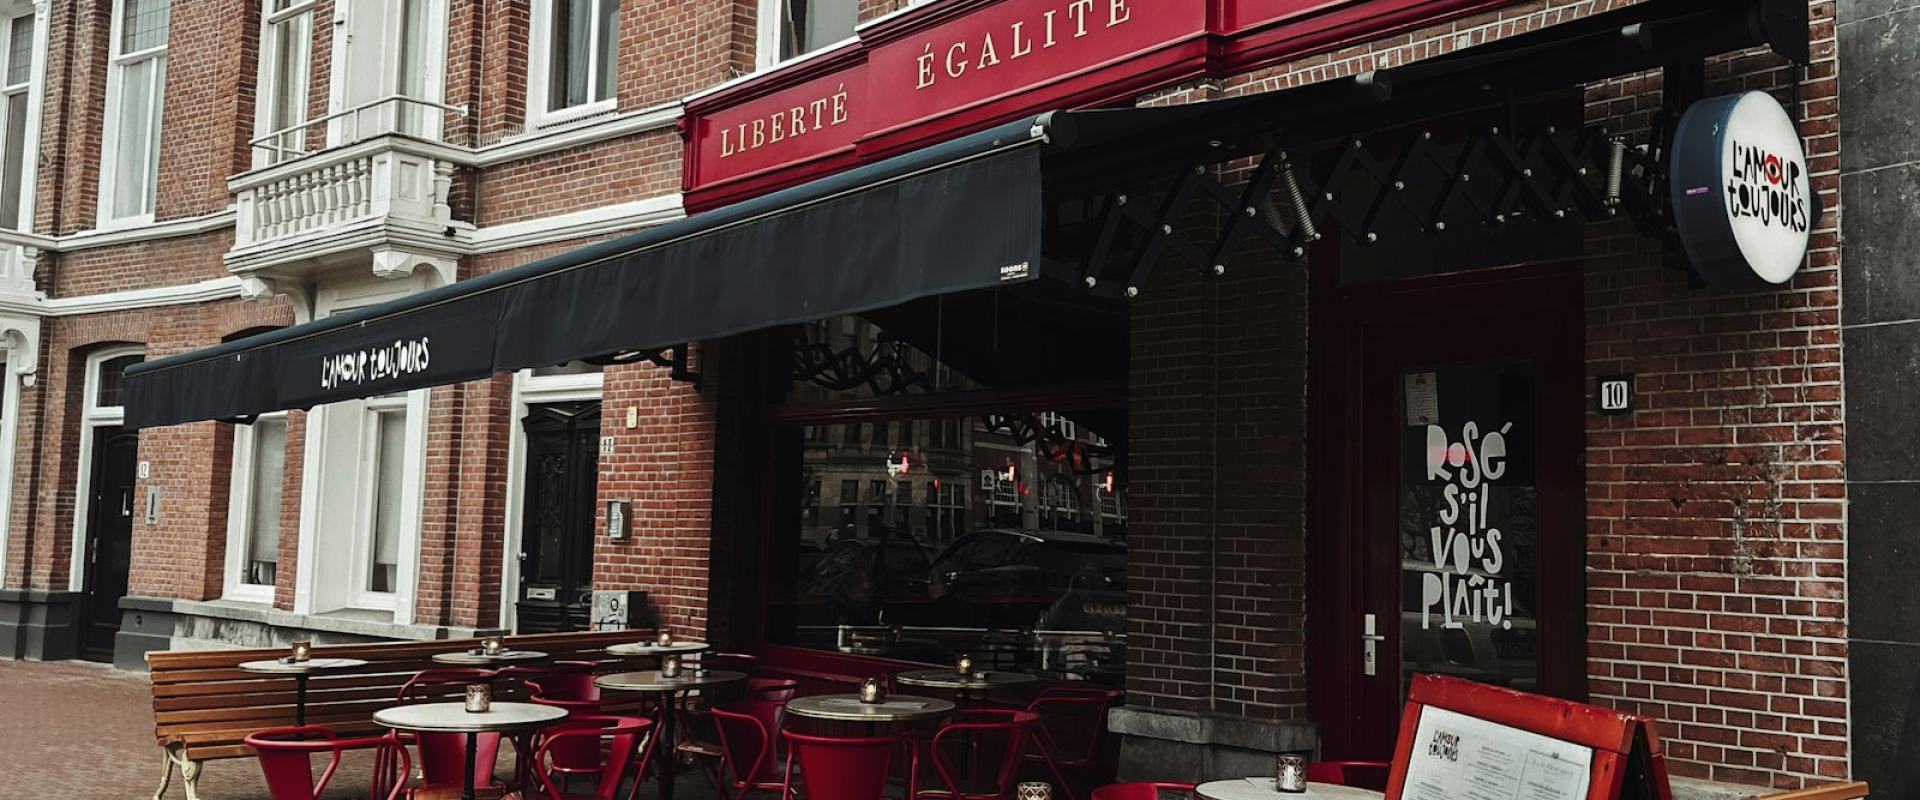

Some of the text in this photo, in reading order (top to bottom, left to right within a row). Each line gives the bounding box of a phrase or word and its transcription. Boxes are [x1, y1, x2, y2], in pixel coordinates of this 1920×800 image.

[719, 83, 848, 159] LIBERTÉ
[1732, 140, 1800, 199] L'AMOUR
[321, 350, 368, 390] L'AMOUR
[1605, 383, 1624, 408] 10
